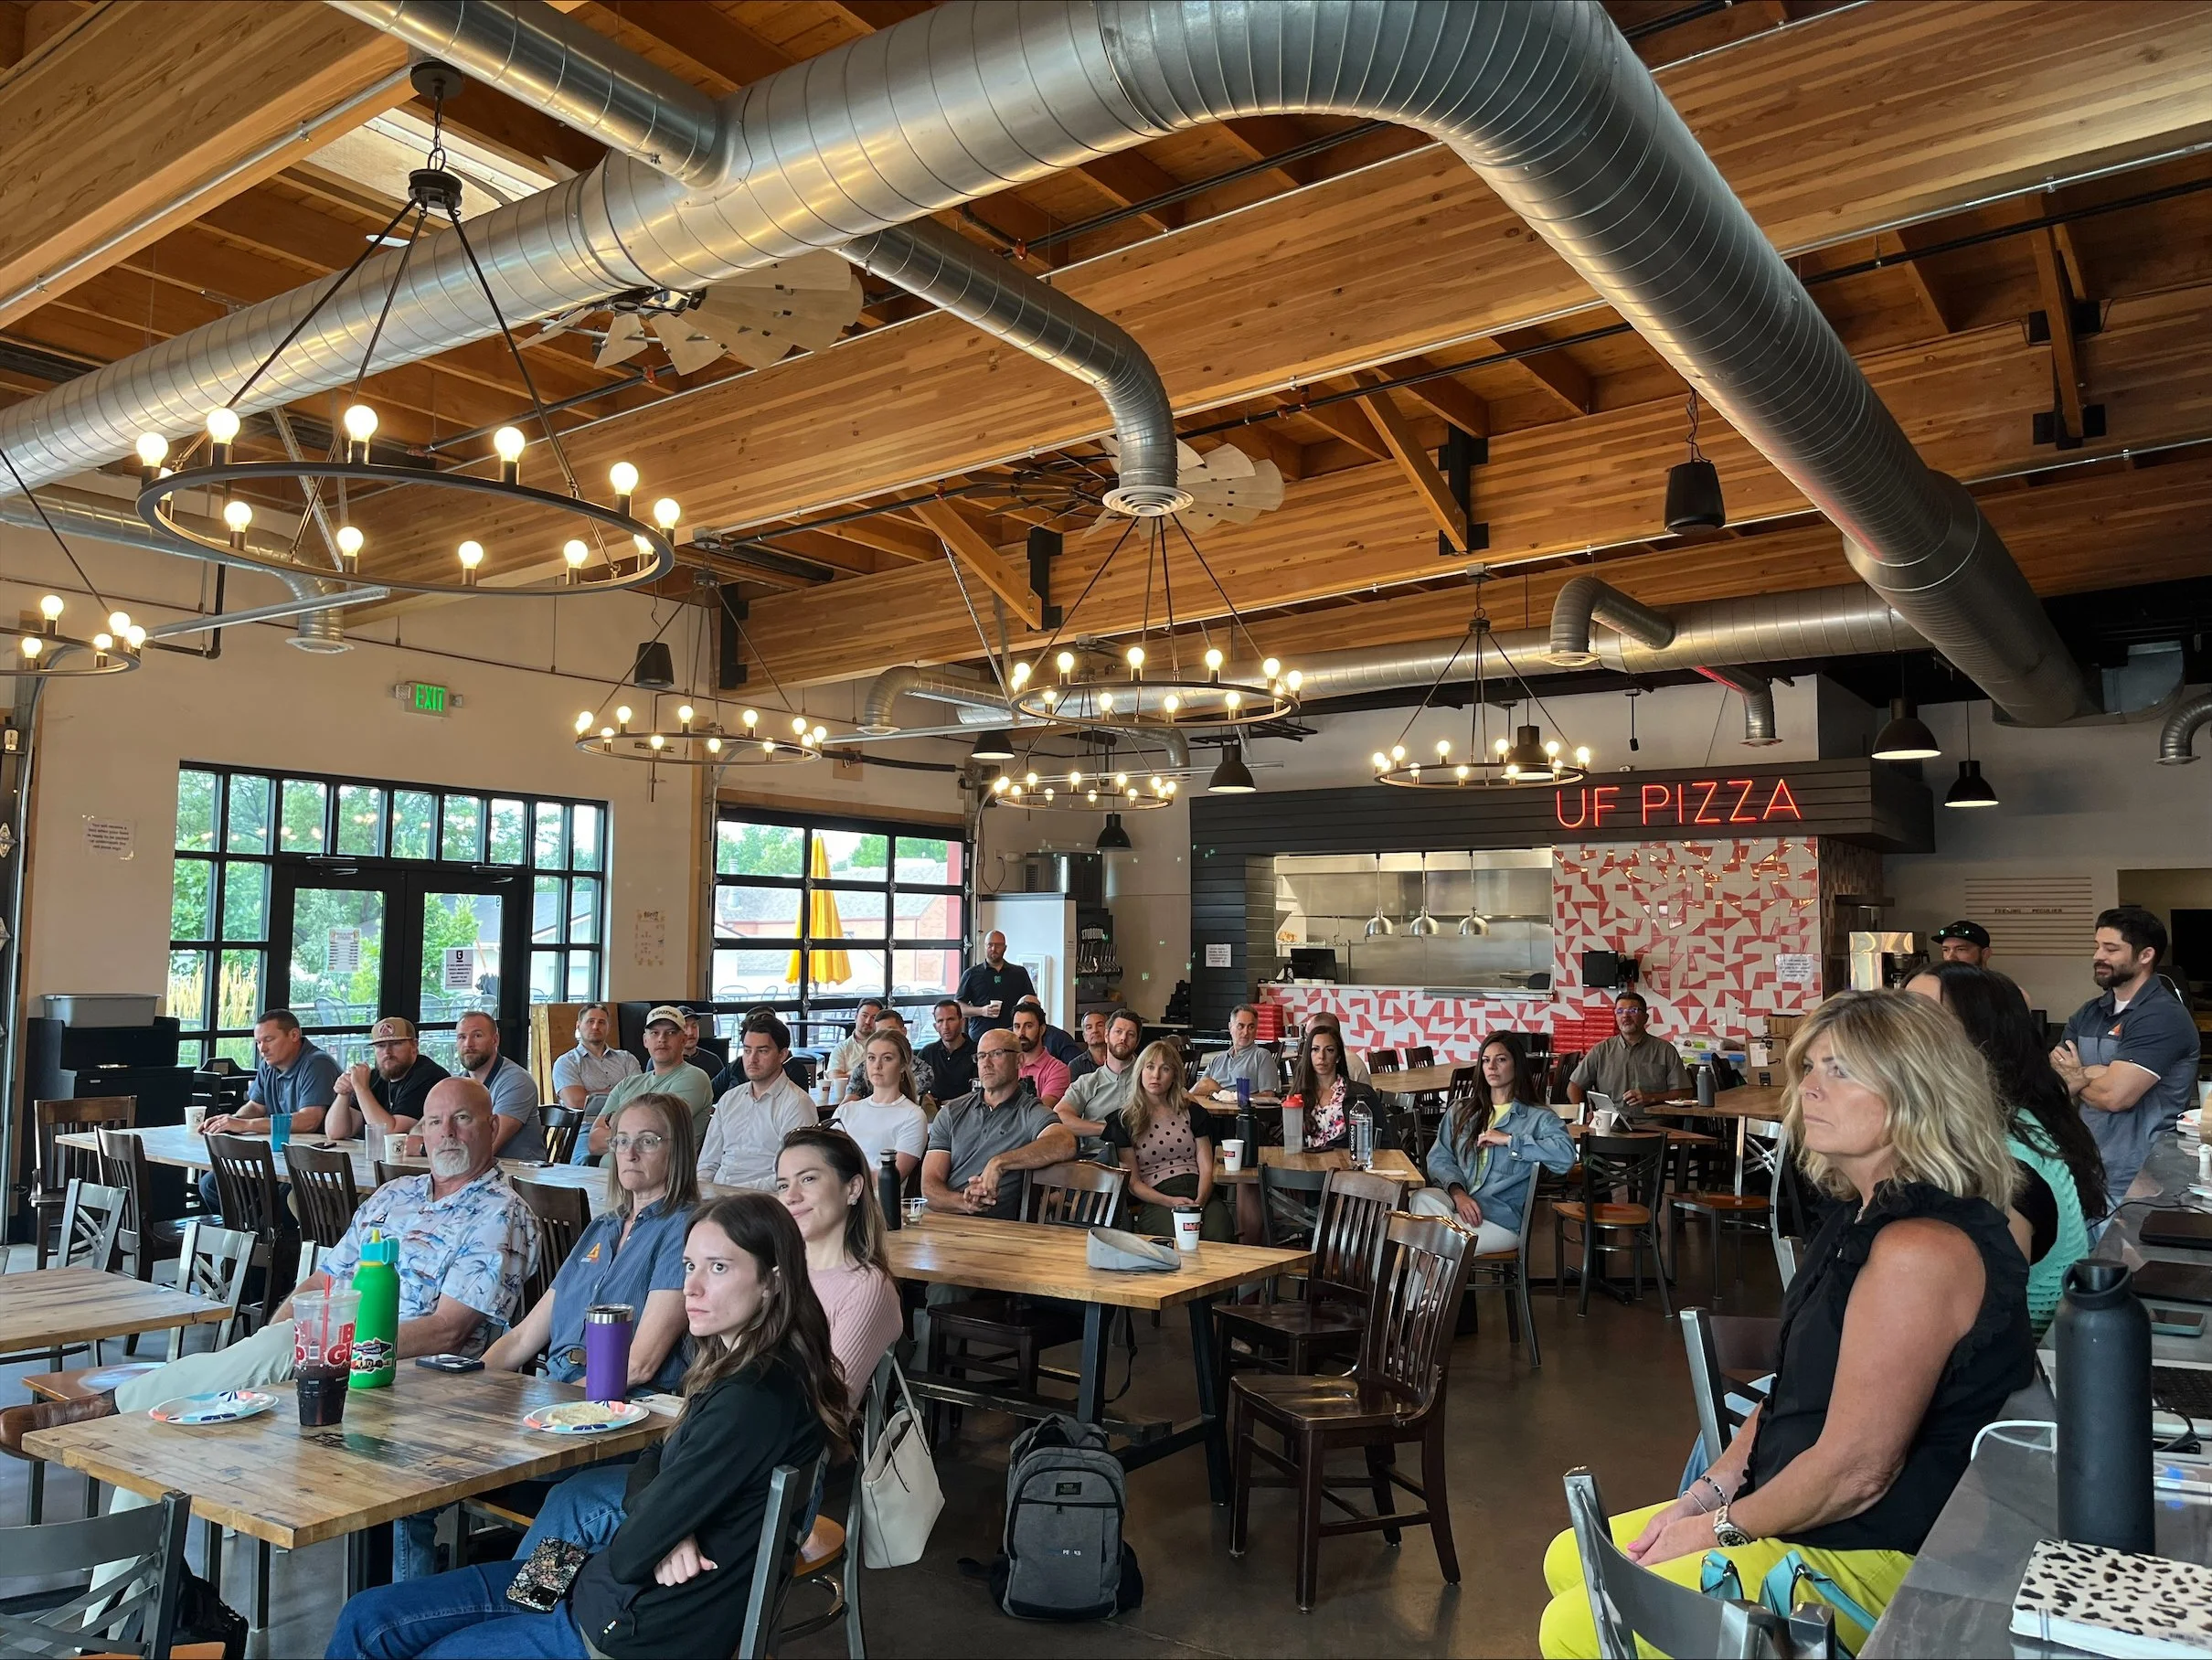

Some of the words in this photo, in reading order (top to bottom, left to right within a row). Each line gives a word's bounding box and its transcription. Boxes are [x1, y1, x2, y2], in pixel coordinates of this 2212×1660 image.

[416, 684, 445, 712] EXIT
[1557, 787, 1620, 828] UF
[1642, 779, 1801, 825] PIZZA
